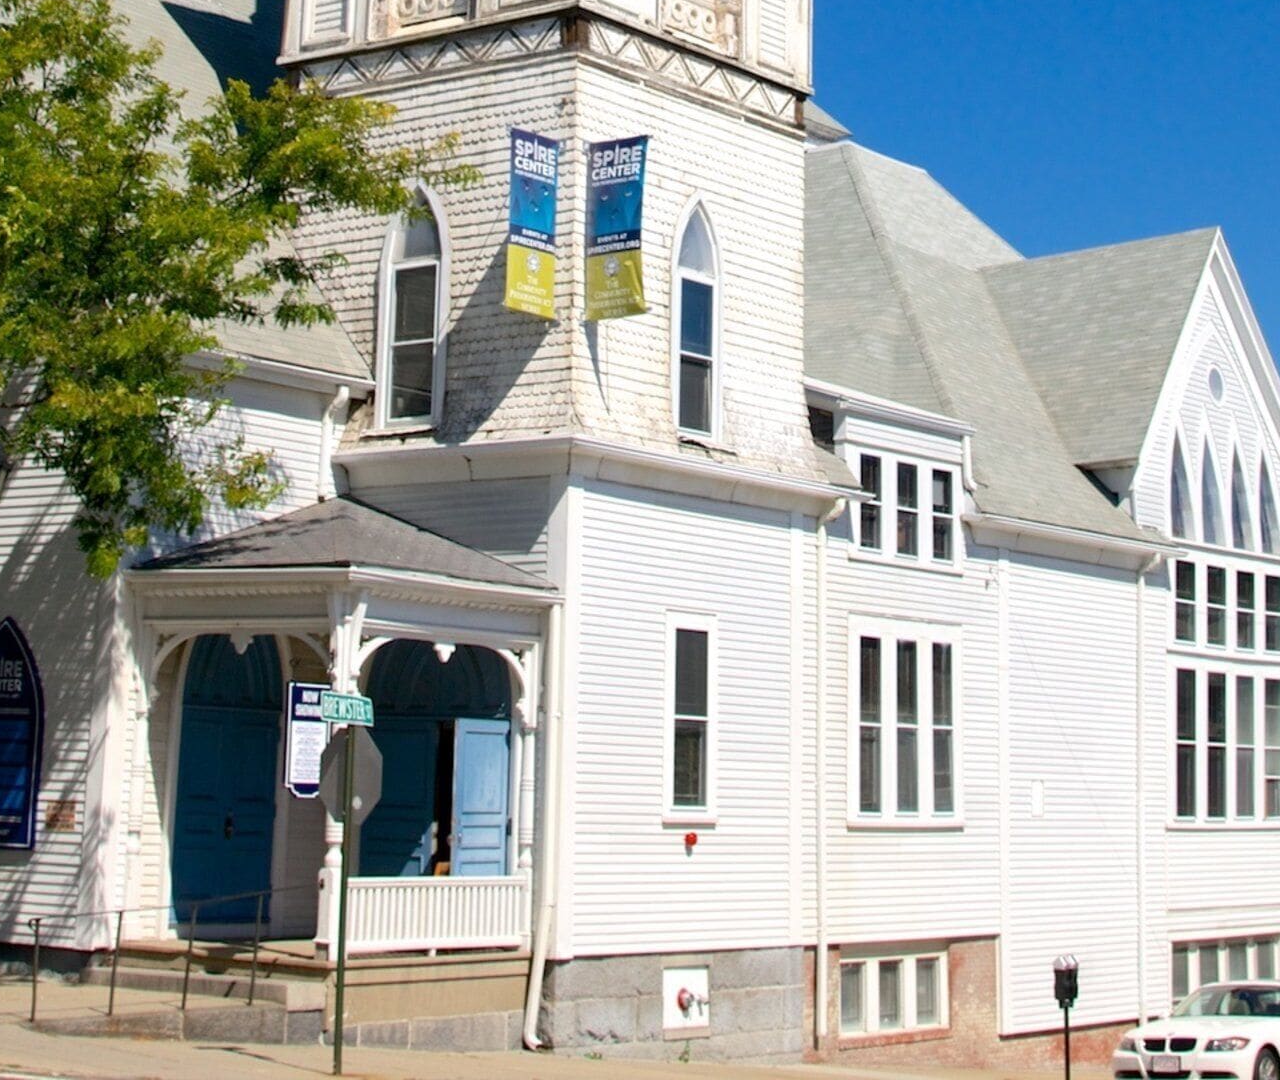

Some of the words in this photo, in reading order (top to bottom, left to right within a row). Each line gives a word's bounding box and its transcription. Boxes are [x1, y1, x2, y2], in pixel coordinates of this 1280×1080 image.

[515, 138, 556, 166] SPIRE
[593, 143, 643, 168] SPIRE
[514, 156, 556, 179] CENTER
[592, 162, 641, 181] CENTER
[324, 696, 366, 720] BREWSTER
